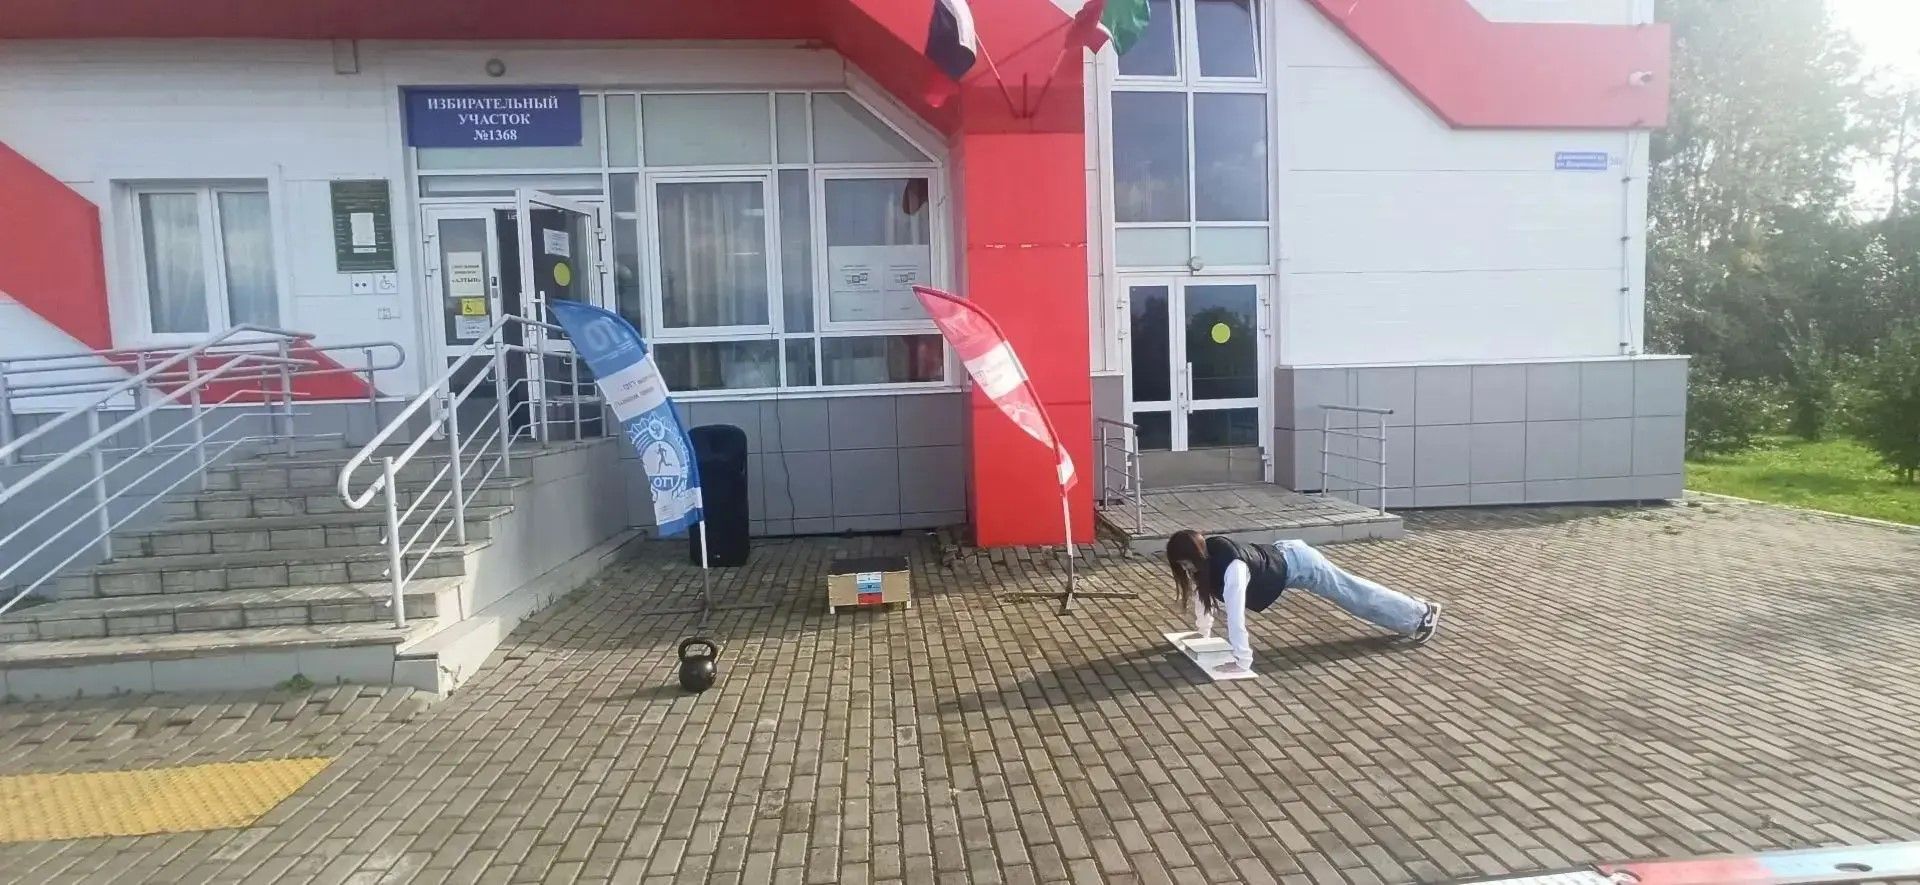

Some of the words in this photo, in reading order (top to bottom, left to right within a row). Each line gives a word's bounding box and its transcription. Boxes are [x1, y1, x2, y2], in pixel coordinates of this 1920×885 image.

[428, 96, 558, 110] ИЗБИРАТЕЛЬНЫЙ
[458, 113, 531, 125] УЧАСТОК
[473, 129, 518, 141] №1368
